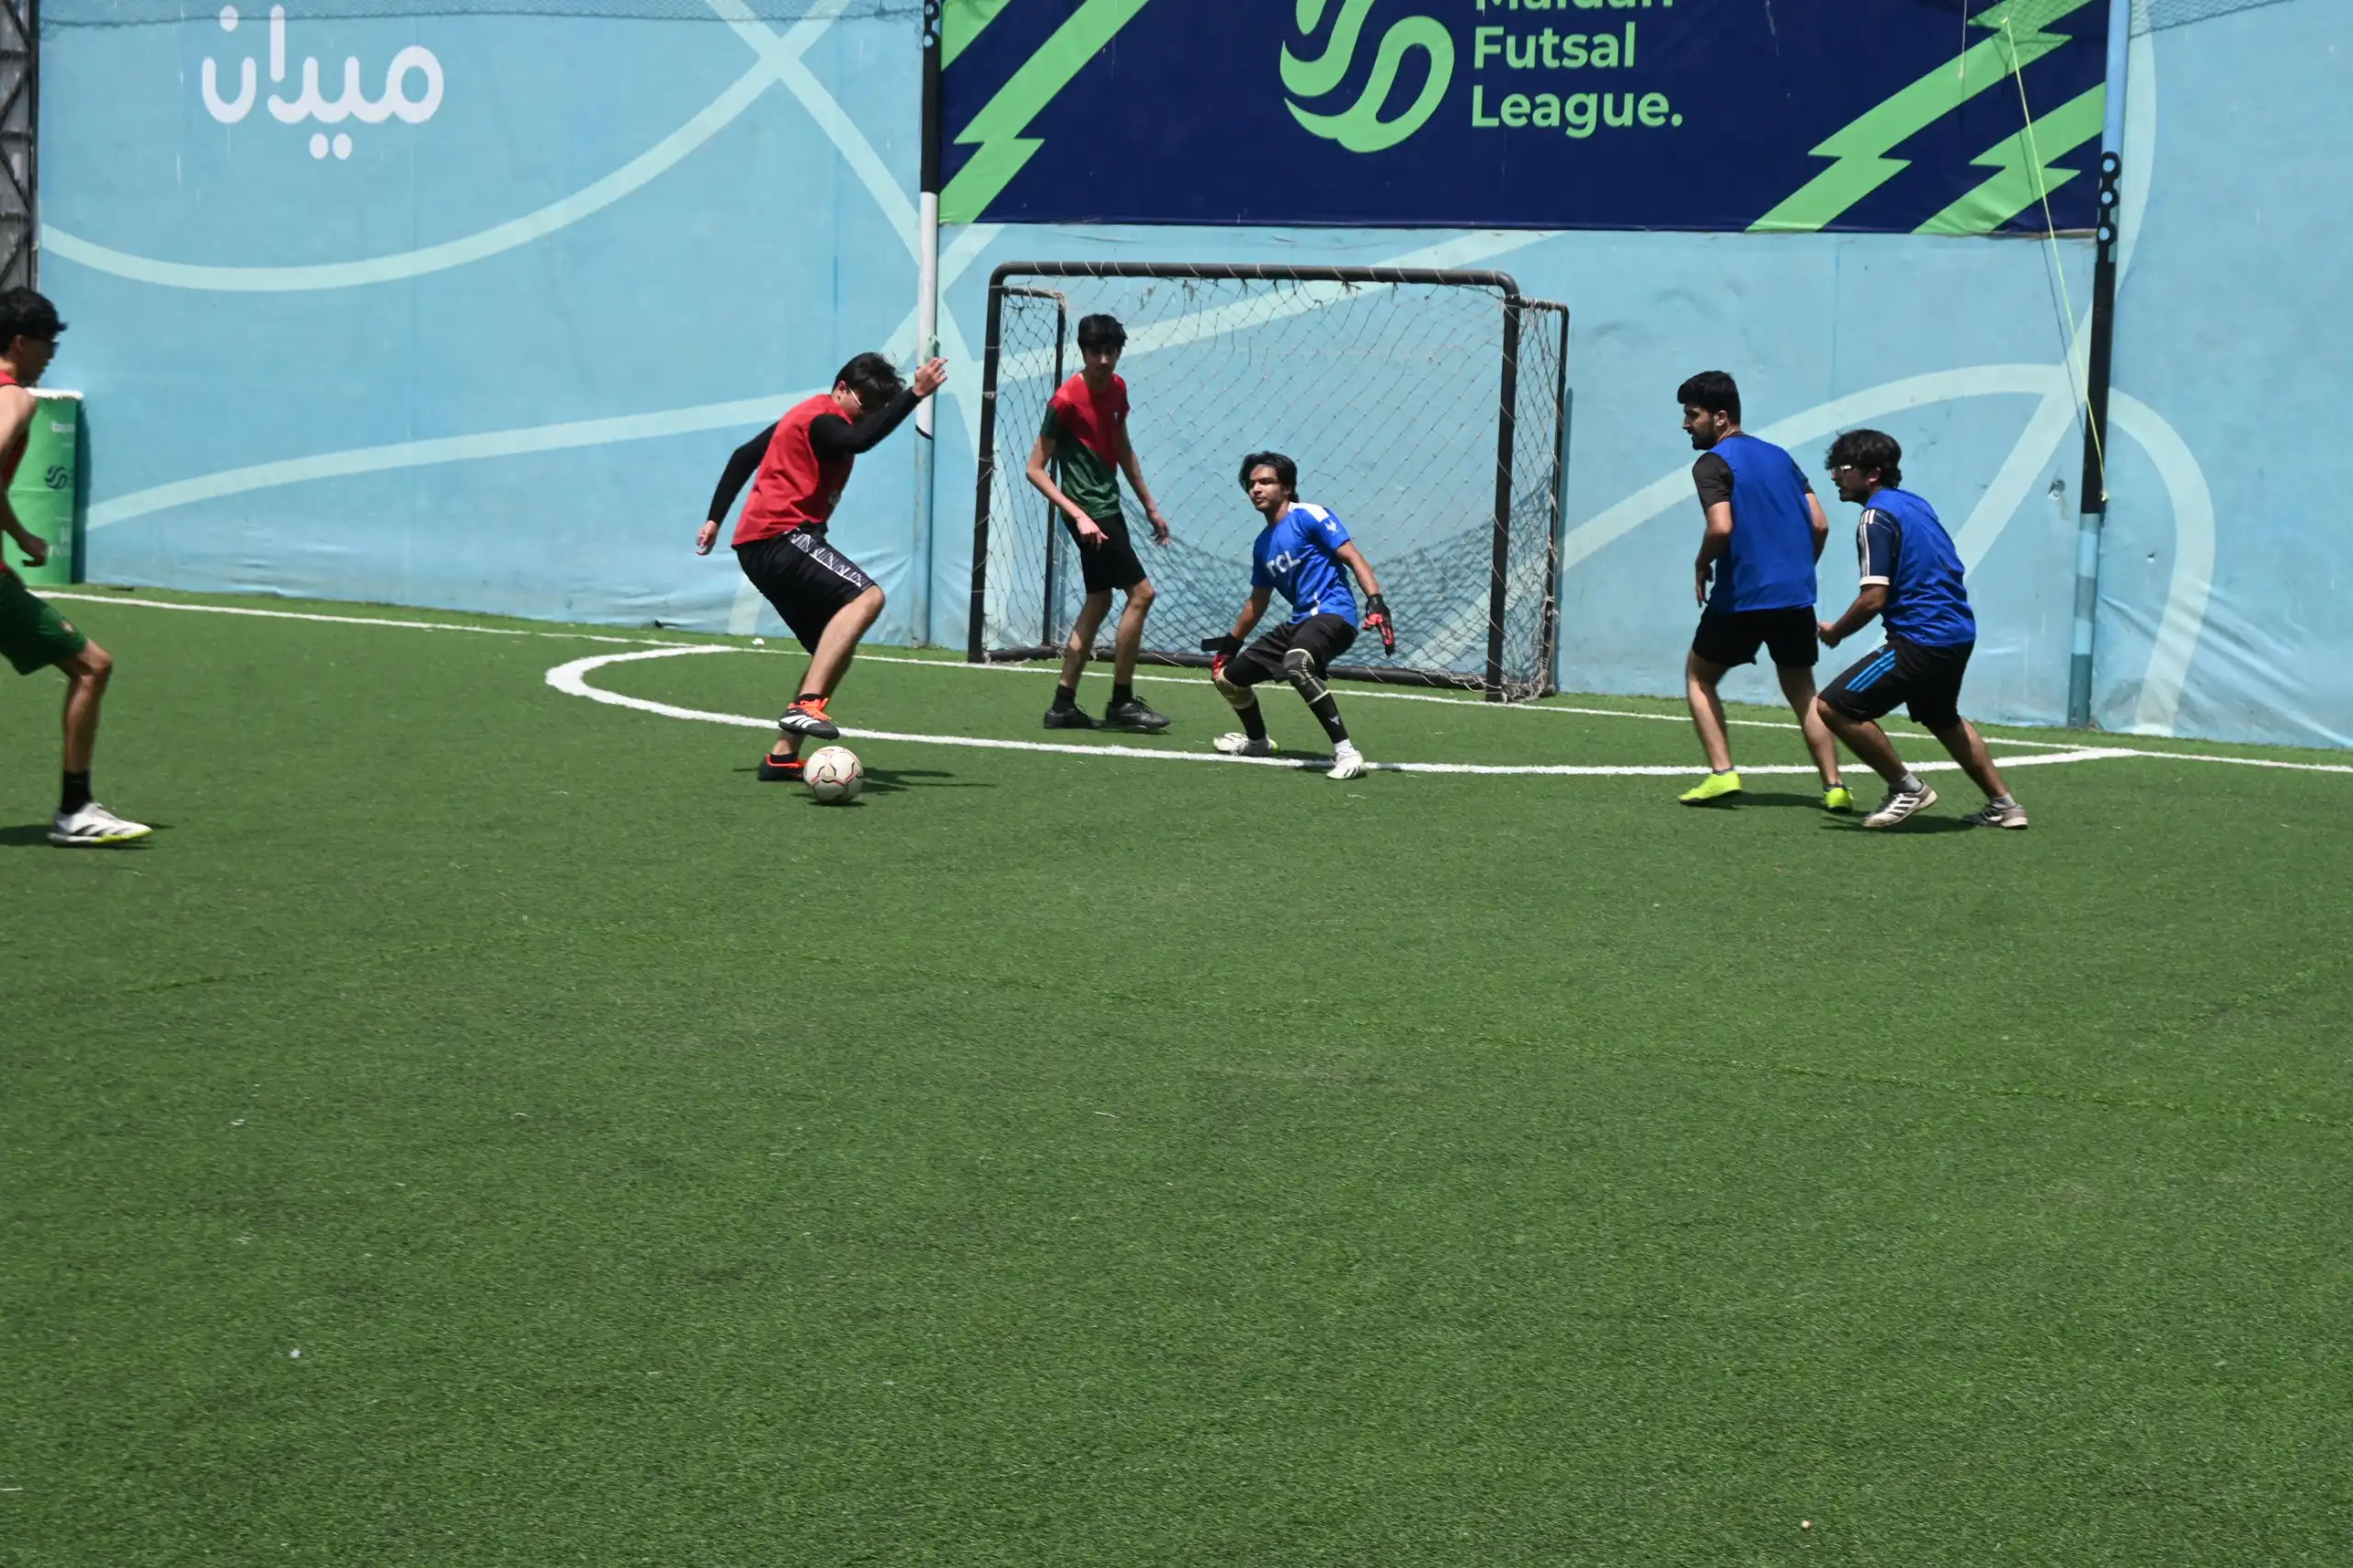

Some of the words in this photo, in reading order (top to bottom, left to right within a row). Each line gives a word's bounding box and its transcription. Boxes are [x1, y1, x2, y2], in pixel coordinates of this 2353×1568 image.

[1473, 22, 1637, 70] Futsal
[1471, 85, 1683, 139] League.
[1265, 551, 1302, 578] TCL
